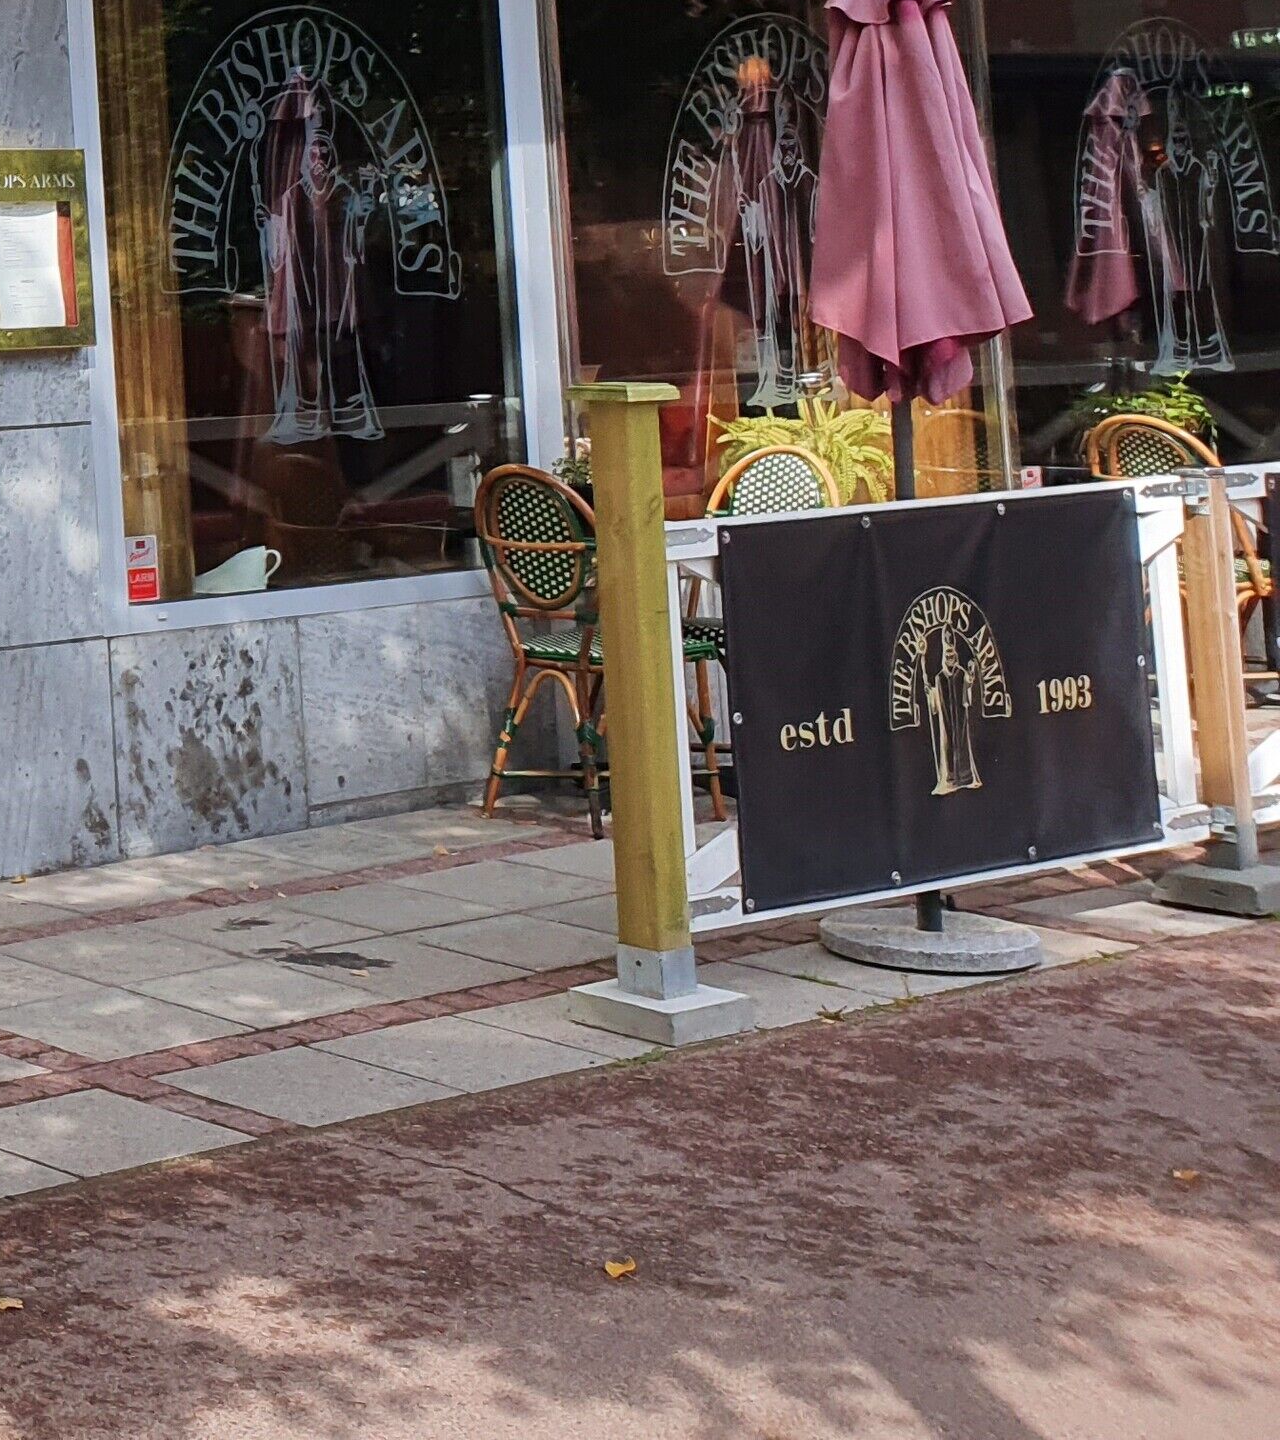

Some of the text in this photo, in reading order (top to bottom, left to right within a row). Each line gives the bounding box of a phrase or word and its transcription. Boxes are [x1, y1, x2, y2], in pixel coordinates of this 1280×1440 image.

[192, 17, 376, 156] BISHOPS
[669, 23, 828, 257] THE BISHOPS
[29, 172, 76, 189] ARMS
[169, 142, 231, 273] THE
[1080, 131, 1120, 240] THE
[779, 673, 1093, 753] estd 1993
[893, 592, 1005, 721] THE BISHOPS ARMS
